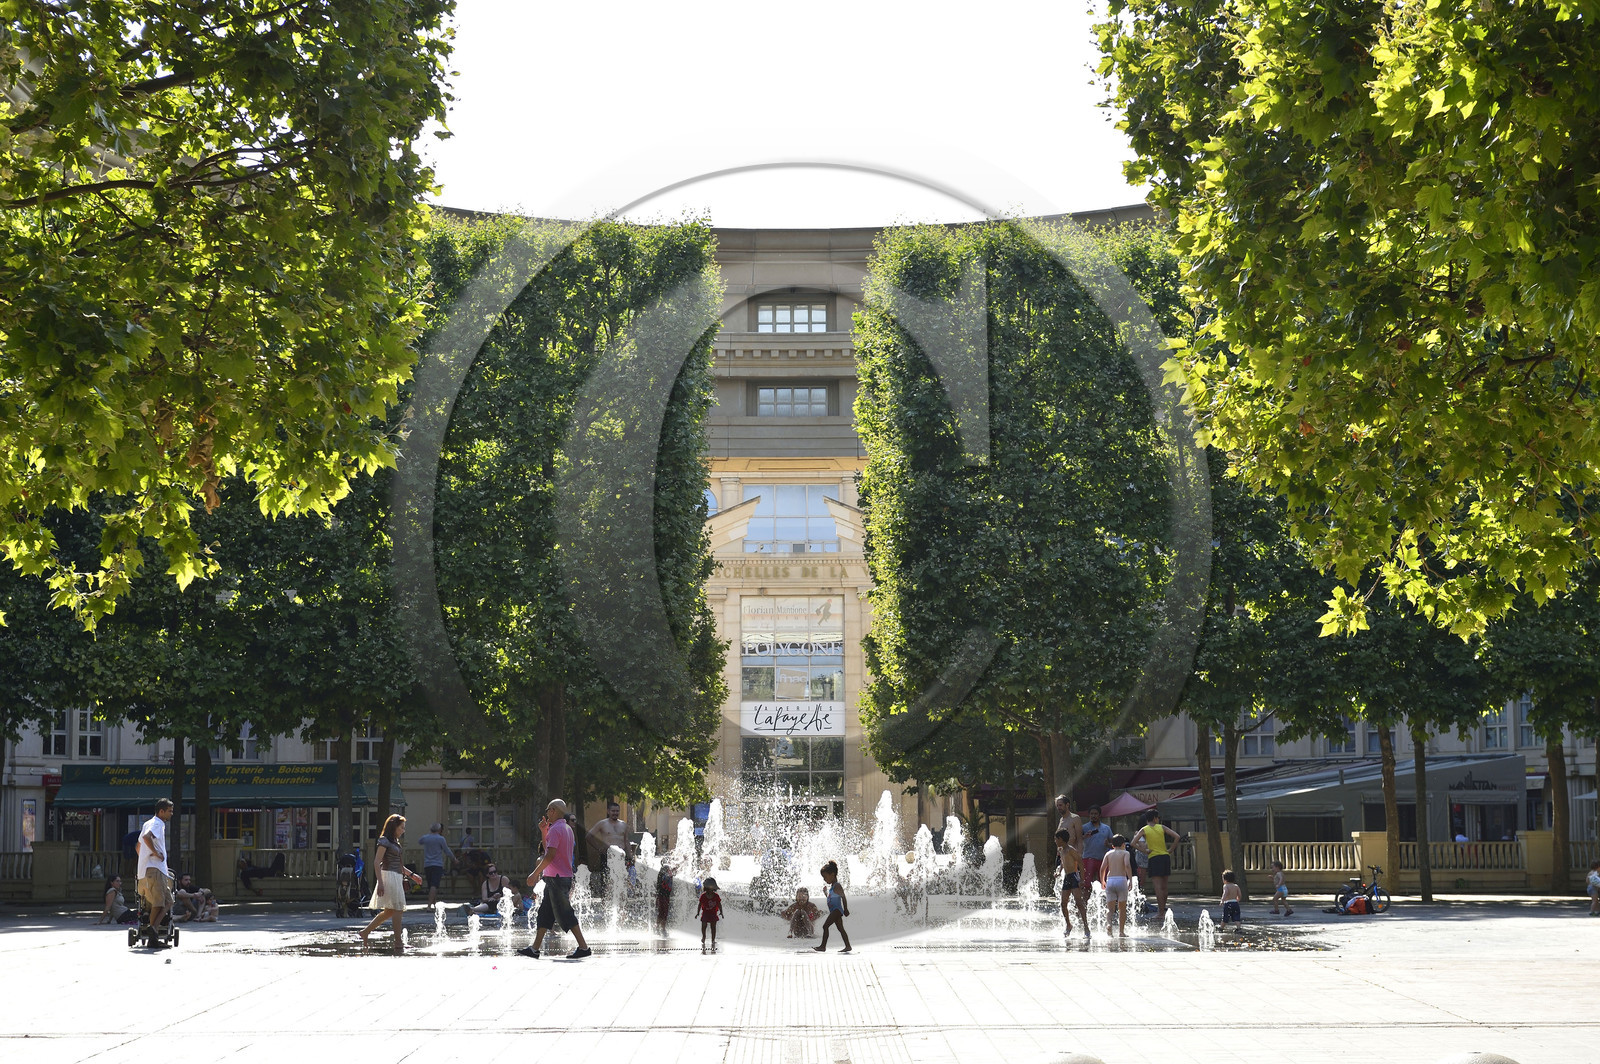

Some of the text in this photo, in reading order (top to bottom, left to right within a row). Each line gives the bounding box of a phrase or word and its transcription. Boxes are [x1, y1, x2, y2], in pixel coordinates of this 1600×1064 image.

[801, 567, 818, 578] DE
[830, 567, 849, 578] LA
[743, 605, 774, 614] Florian
[743, 642, 843, 656] POLYGONE
[780, 673, 807, 684] fnac
[754, 703, 832, 735] Lafayette
[102, 766, 130, 775] Pains
[225, 766, 264, 774] Tarterie
[278, 766, 323, 774] Boissons
[251, 776, 315, 785] Restauration
